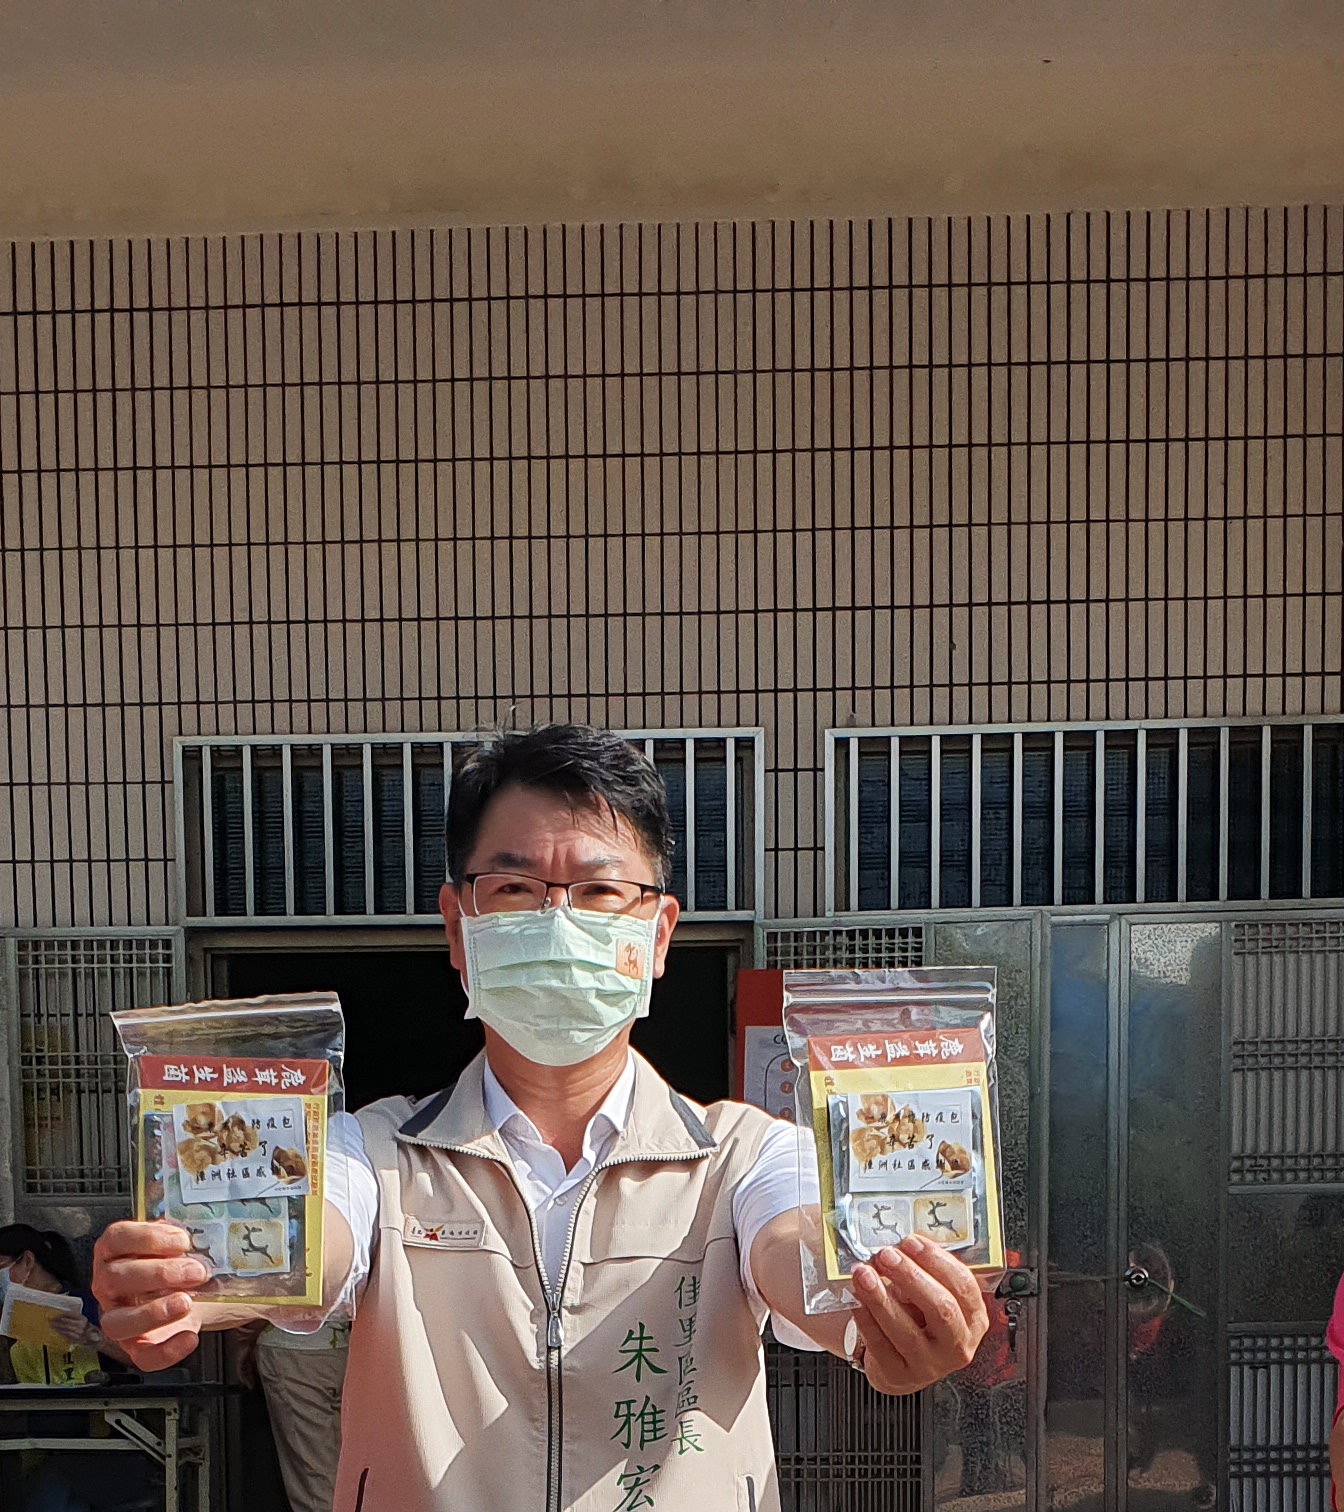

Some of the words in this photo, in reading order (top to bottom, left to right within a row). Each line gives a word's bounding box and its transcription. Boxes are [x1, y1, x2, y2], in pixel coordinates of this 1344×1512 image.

[830, 1034, 964, 1062] 鹿茸益生菌
[163, 1063, 307, 1090] 鹿茸益生菌
